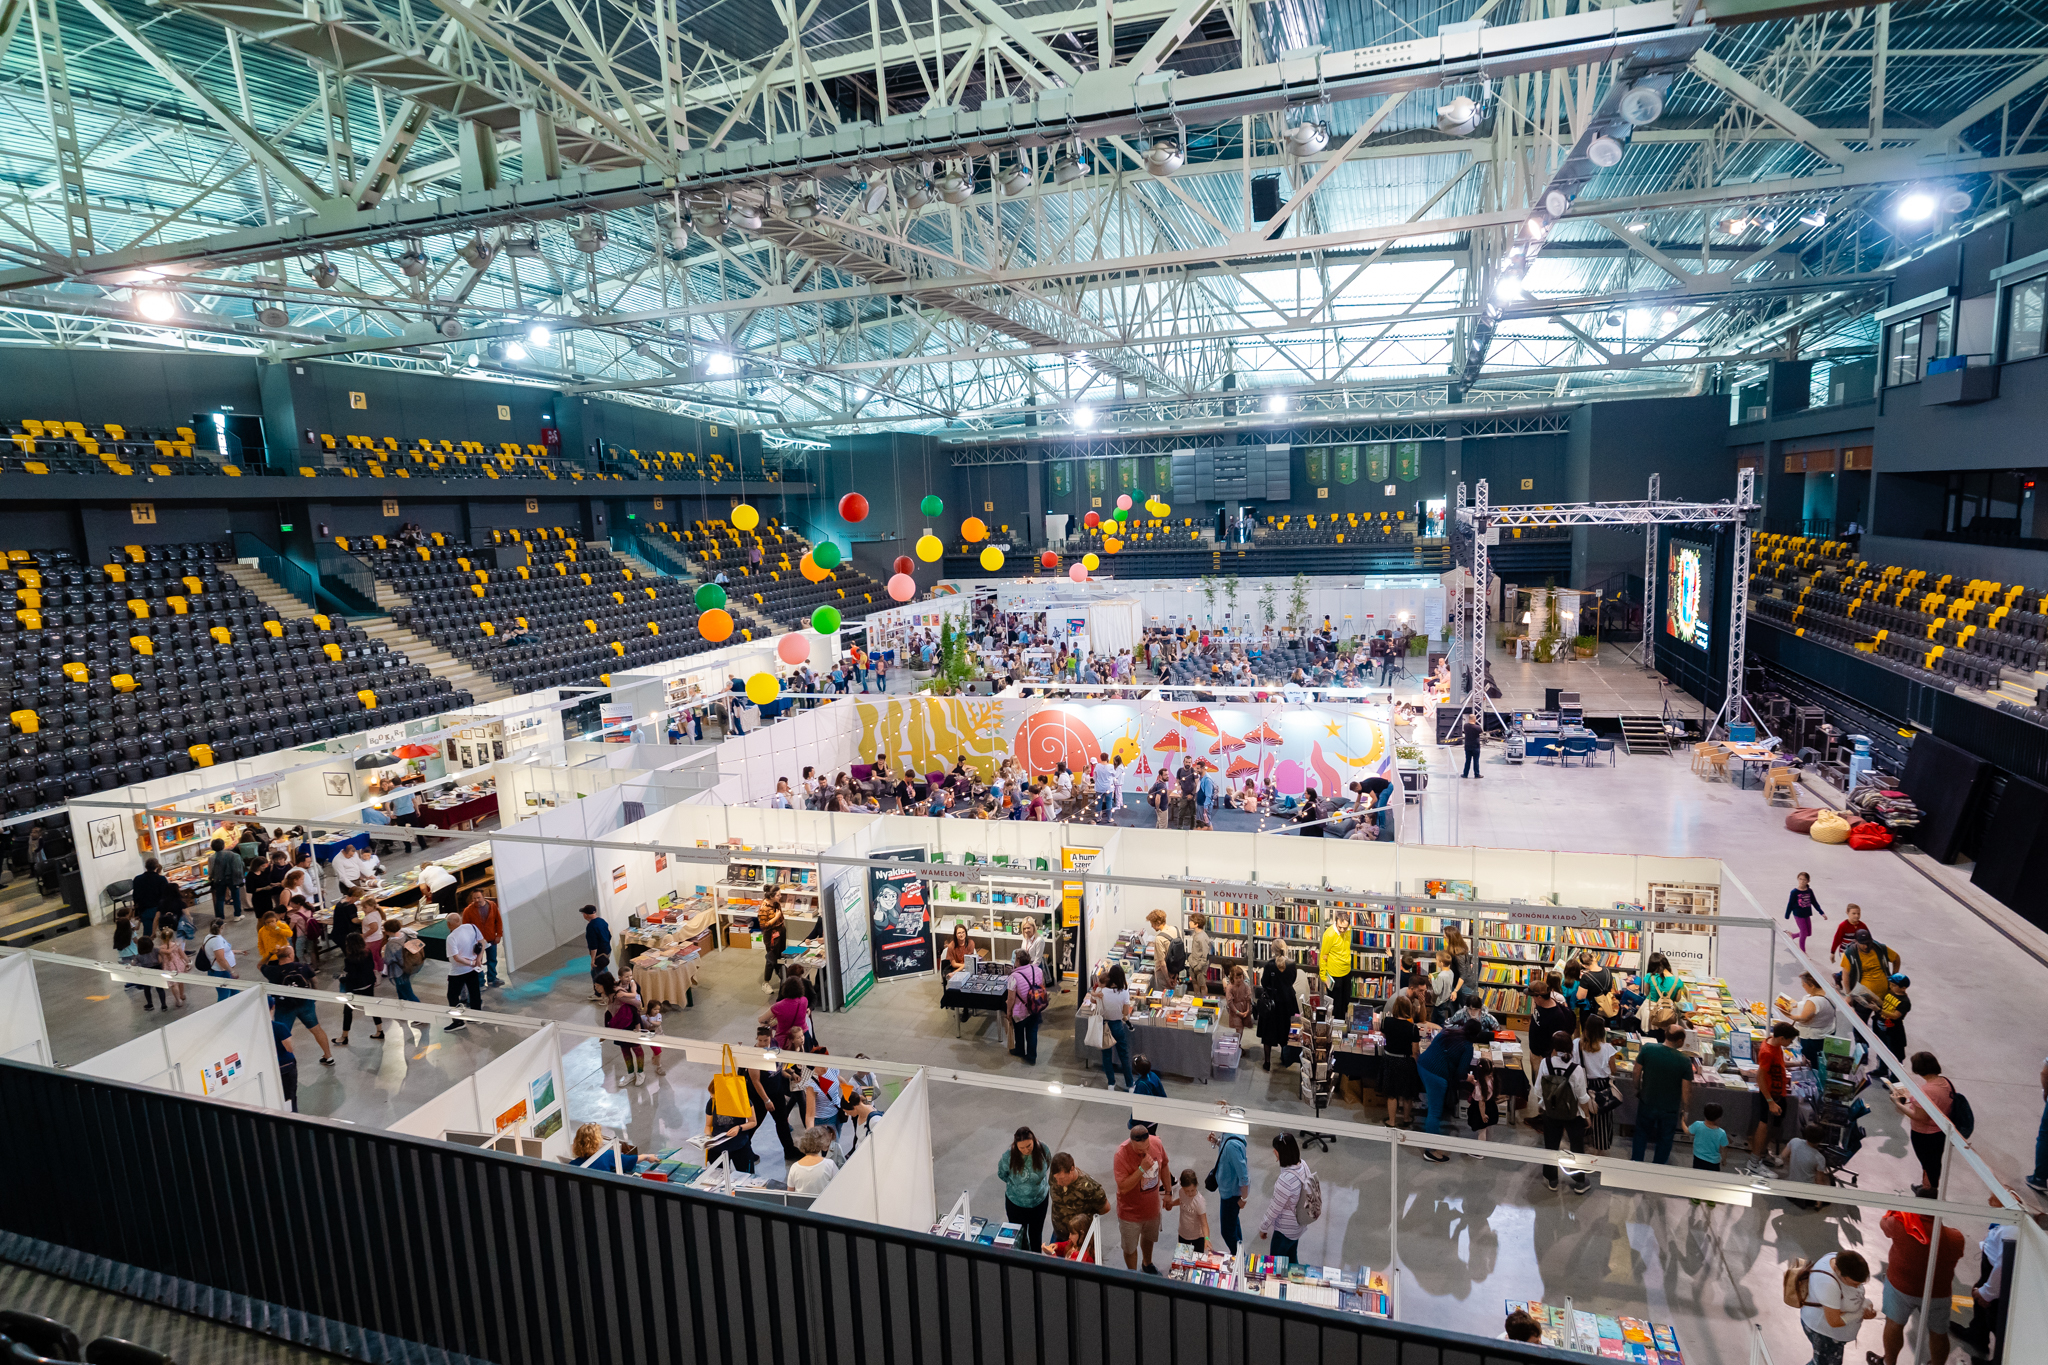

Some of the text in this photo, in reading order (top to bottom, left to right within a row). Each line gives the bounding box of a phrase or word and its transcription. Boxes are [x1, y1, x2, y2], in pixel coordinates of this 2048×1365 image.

[136, 506, 150, 519] H
[386, 502, 396, 513] H
[1072, 853, 1078, 861] A
[920, 868, 965, 877] WAMELEON
[1213, 890, 1259, 900] KÖNYVTÉR
